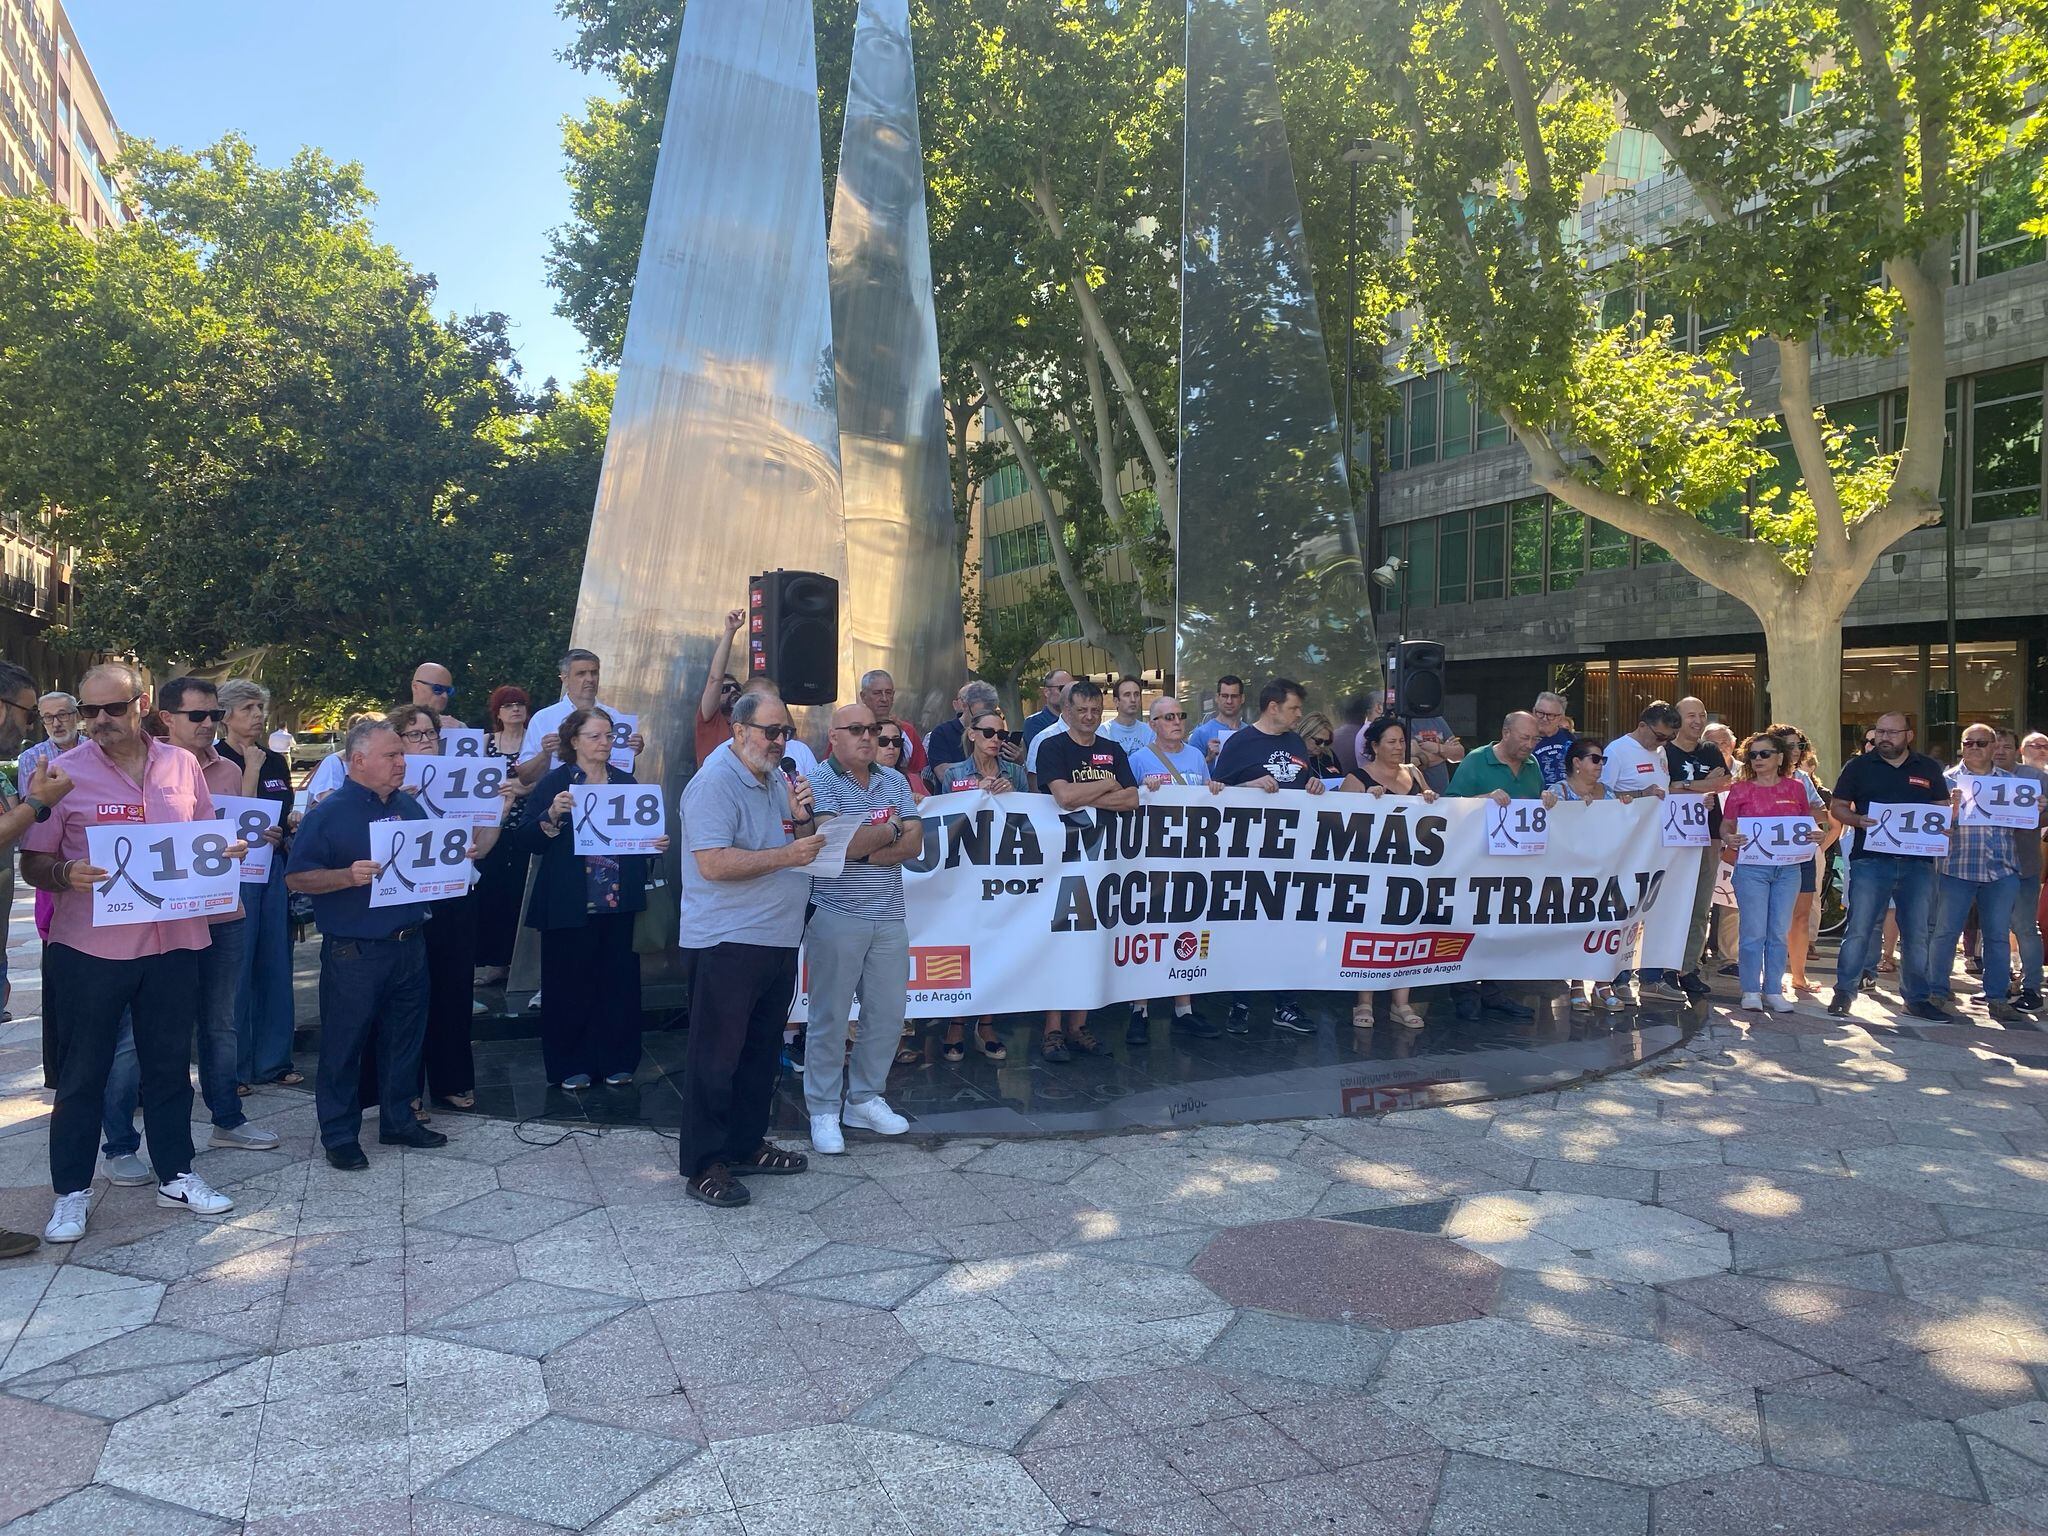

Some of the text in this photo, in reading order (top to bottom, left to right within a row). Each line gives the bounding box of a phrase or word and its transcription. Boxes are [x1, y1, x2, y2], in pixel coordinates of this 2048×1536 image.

[444, 768, 502, 799] 18
[1990, 784, 2036, 807] 18
[98, 805, 126, 814] UGT
[606, 794, 660, 826] 18
[870, 809, 889, 820] UGT
[1515, 807, 1546, 832] 18
[1682, 802, 1706, 826] 18
[1770, 822, 1812, 846] 18
[1898, 810, 1946, 836] 18
[412, 828, 468, 868] 18
[902, 810, 1043, 874] UNA
[1058, 804, 1300, 862] MUERTE
[1311, 806, 1448, 866] MÁS
[149, 834, 232, 882] 18
[380, 887, 397, 896] 2025
[982, 870, 1666, 932] por ACCIDENTE DE TRABAJO
[107, 902, 134, 912] 2025
[170, 902, 188, 910] UGT
[1114, 933, 1169, 967] UGT
[1350, 938, 1432, 962] CCOO
[1168, 966, 1206, 981] Aragón
[1340, 964, 1461, 978] comisiones obreras de Aragón
[914, 992, 929, 1002] de
[931, 990, 972, 1004] Aragón
